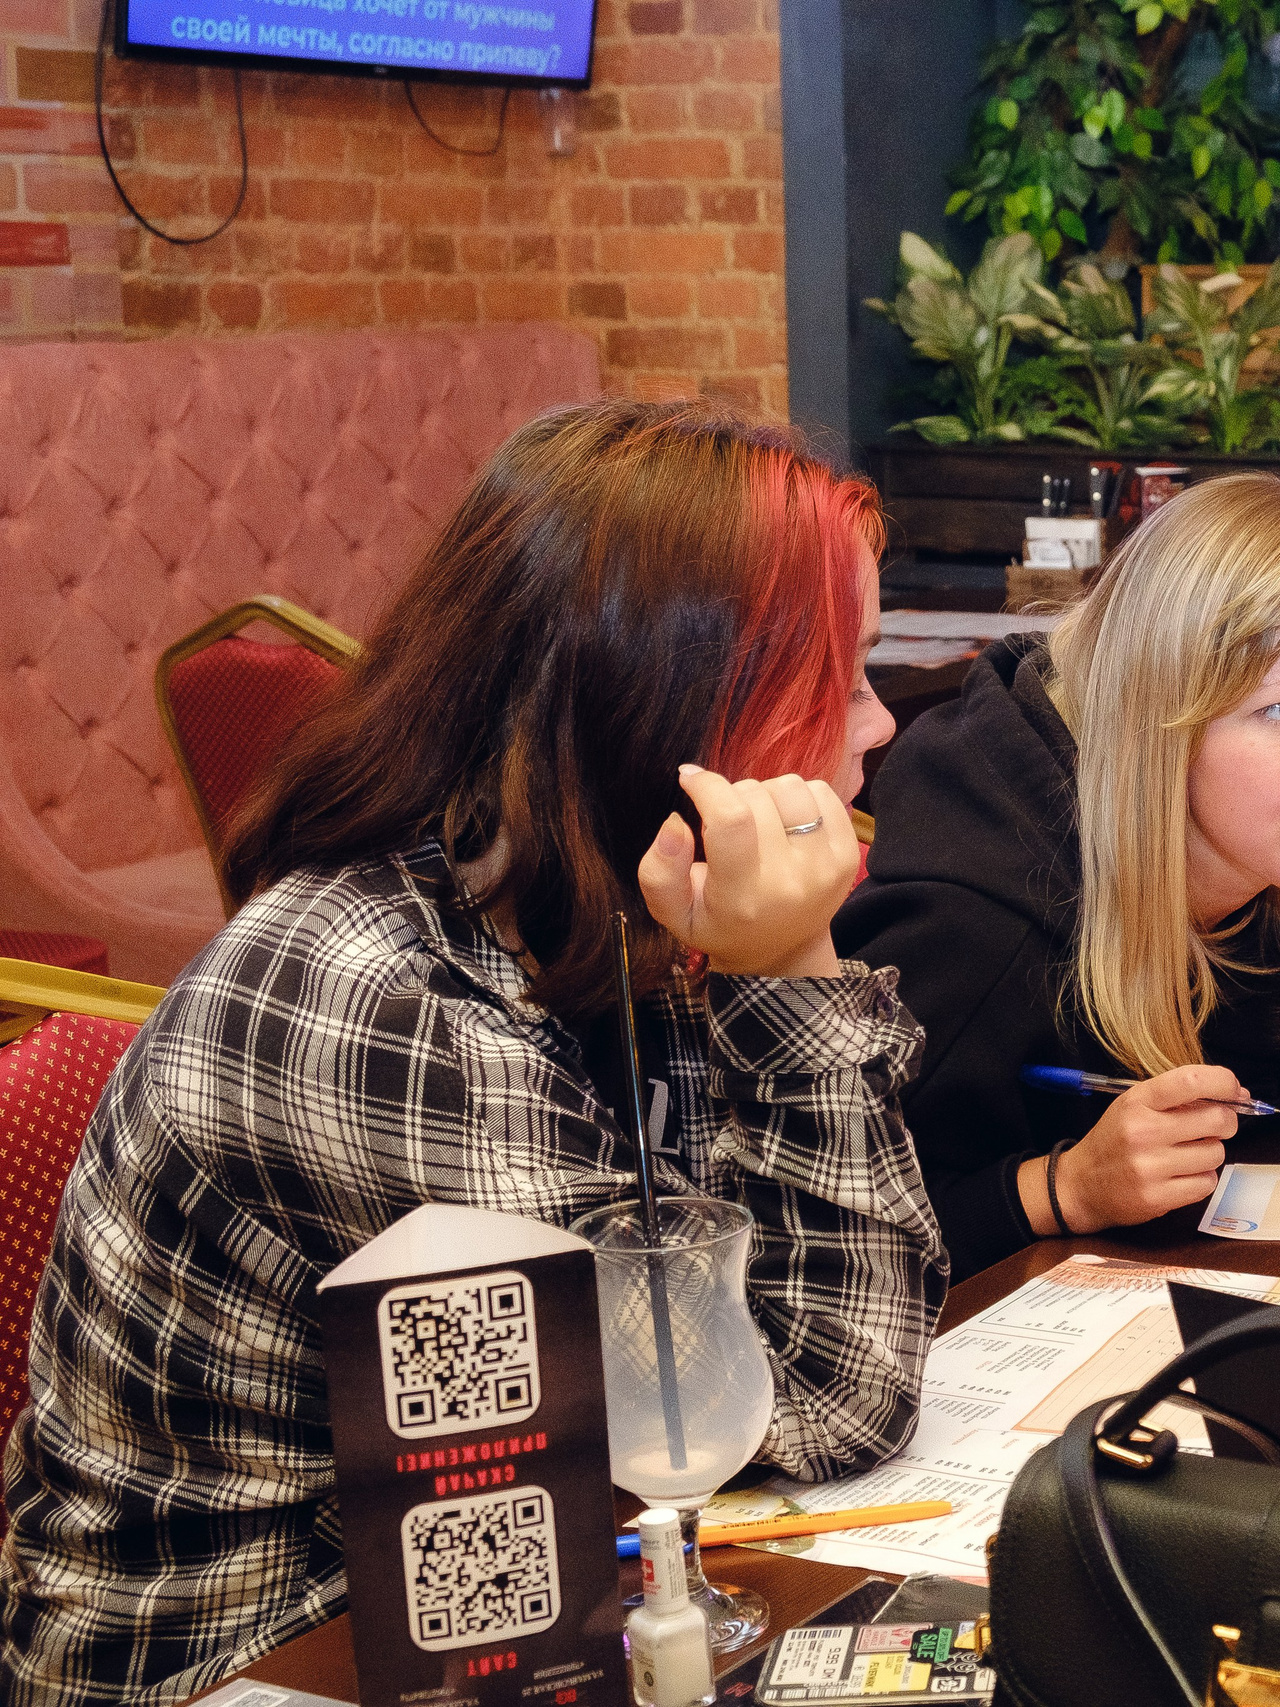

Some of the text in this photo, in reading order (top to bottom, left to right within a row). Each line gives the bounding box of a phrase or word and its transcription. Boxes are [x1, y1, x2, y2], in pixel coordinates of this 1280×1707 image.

[423, 0, 448, 21] от
[454, 3, 555, 32] мужчины
[171, 14, 563, 76] своей мечты, согласно припеву?
[396, 1432, 547, 1473] ПРИЛОЖЕНИЕ!
[435, 1463, 515, 1496] СКАЧАЙ
[826, 1647, 842, 1665] 9.99
[916, 1633, 939, 1659] SALE
[466, 1650, 518, 1677] САЙТ
